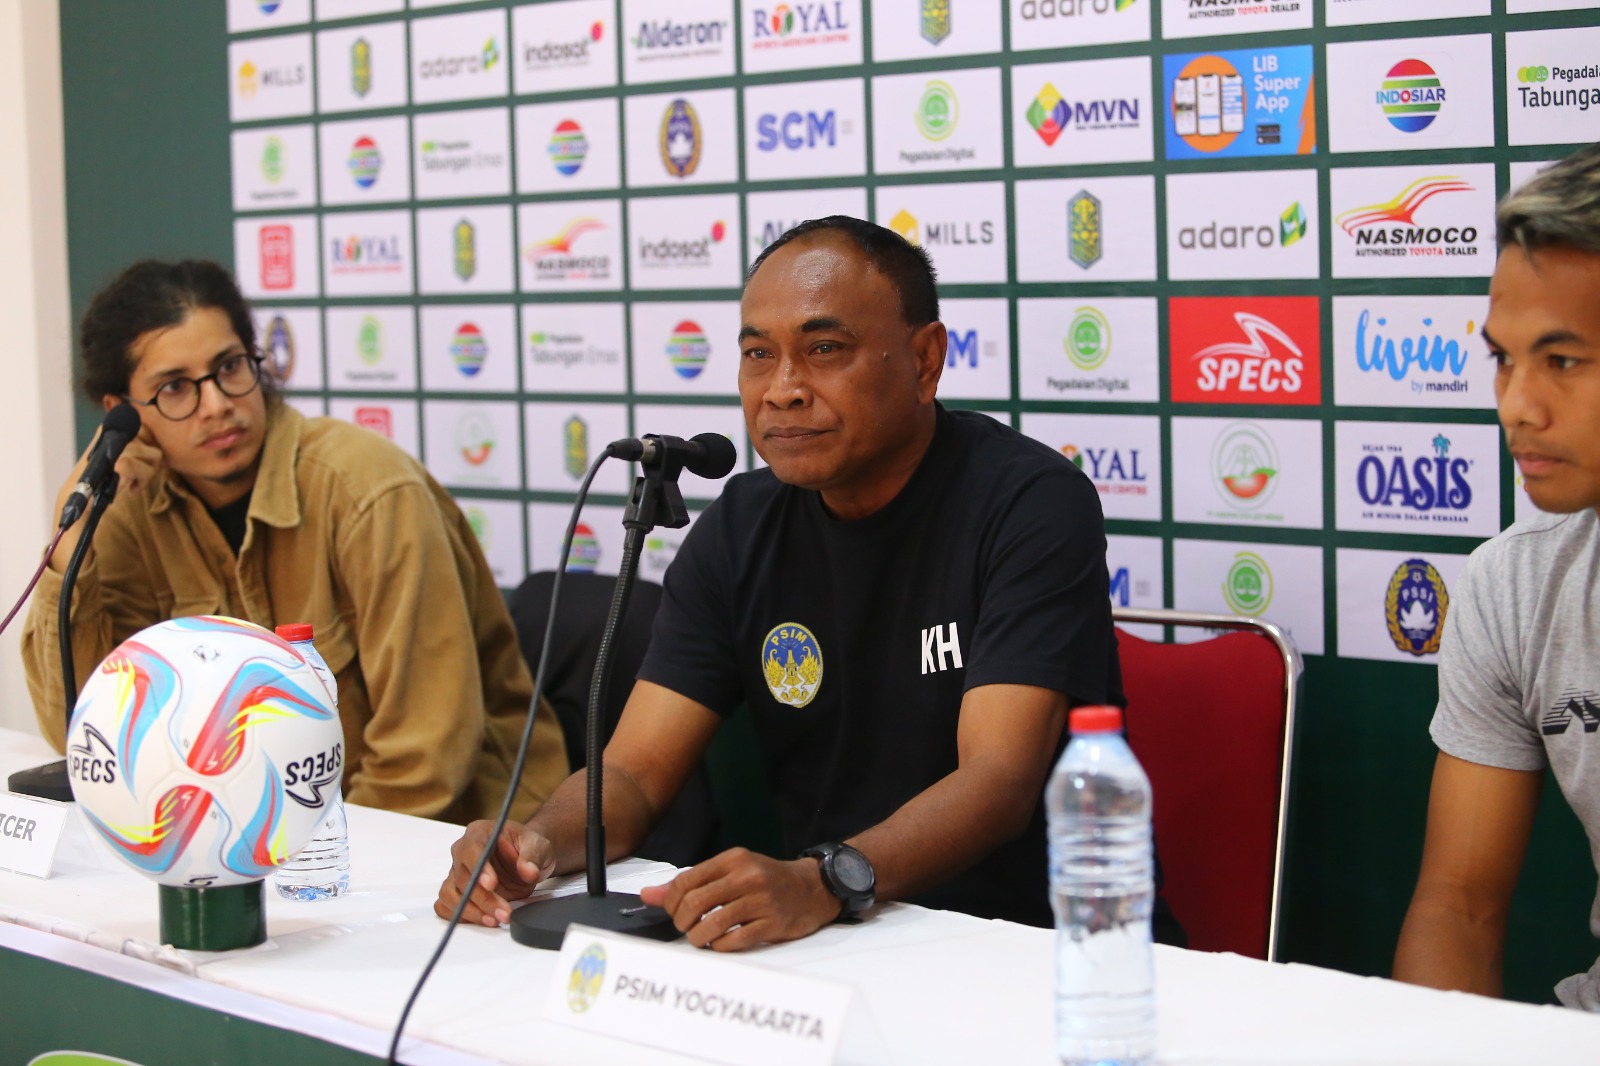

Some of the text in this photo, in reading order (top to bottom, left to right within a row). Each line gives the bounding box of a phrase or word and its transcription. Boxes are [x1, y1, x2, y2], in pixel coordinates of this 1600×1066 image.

[1188, 9, 1235, 19] AUTHORIZED
[1238, 6, 1269, 14] TOYOTA
[1270, 3, 1300, 13] DEALER
[637, 20, 722, 49] Alderon
[1252, 54, 1279, 73] LIB
[1552, 64, 1600, 83] Pegadai
[1254, 75, 1301, 95] Super
[1255, 94, 1290, 113] App
[1375, 88, 1446, 105] INDOSIAR
[1076, 99, 1139, 123] MVN
[757, 110, 836, 151] SCM
[926, 221, 994, 245] MILLS
[1178, 221, 1275, 249] adaro
[1355, 227, 1478, 245] NASMOCO
[1355, 246, 1478, 257] AUTHORIZED TOYOTA DEALER
[1197, 357, 1304, 393] SPECS
[1410, 380, 1468, 394] by mandiri
[1357, 455, 1472, 511] OASIS
[1402, 586, 1433, 603] PSSI
[770, 628, 808, 647] PSIM
[921, 621, 964, 675] KH
[285, 743, 342, 786] SPECS
[614, 973, 824, 1041] PSIM YOGYAKARTA
